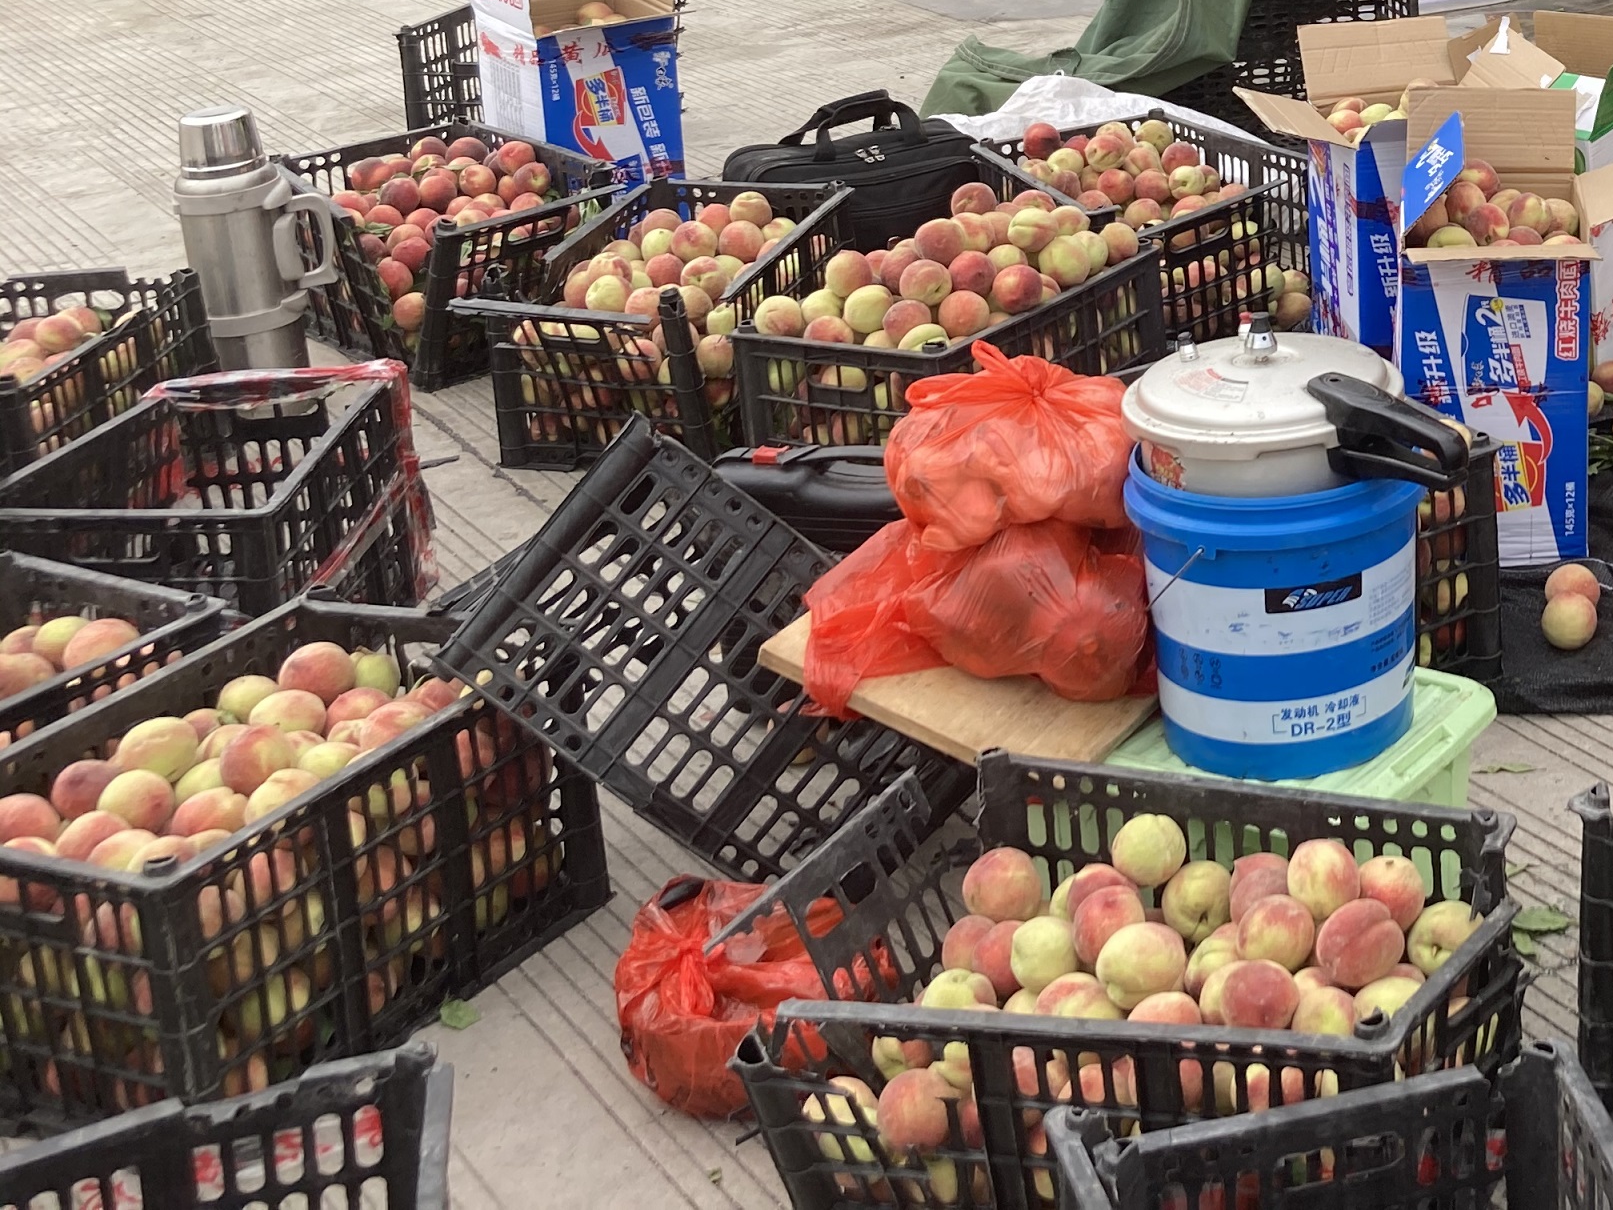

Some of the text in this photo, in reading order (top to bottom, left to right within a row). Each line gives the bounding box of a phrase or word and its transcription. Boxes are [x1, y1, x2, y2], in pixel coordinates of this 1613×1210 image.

[584, 77, 615, 123] 多半桶
[630, 86, 661, 139] 新包装
[1557, 260, 1580, 359] 红烧牛肉面
[1500, 445, 1531, 505] 多半桶
[1280, 693, 1361, 721] 发动机 冷却液
[1291, 712, 1352, 737] DR-2型
